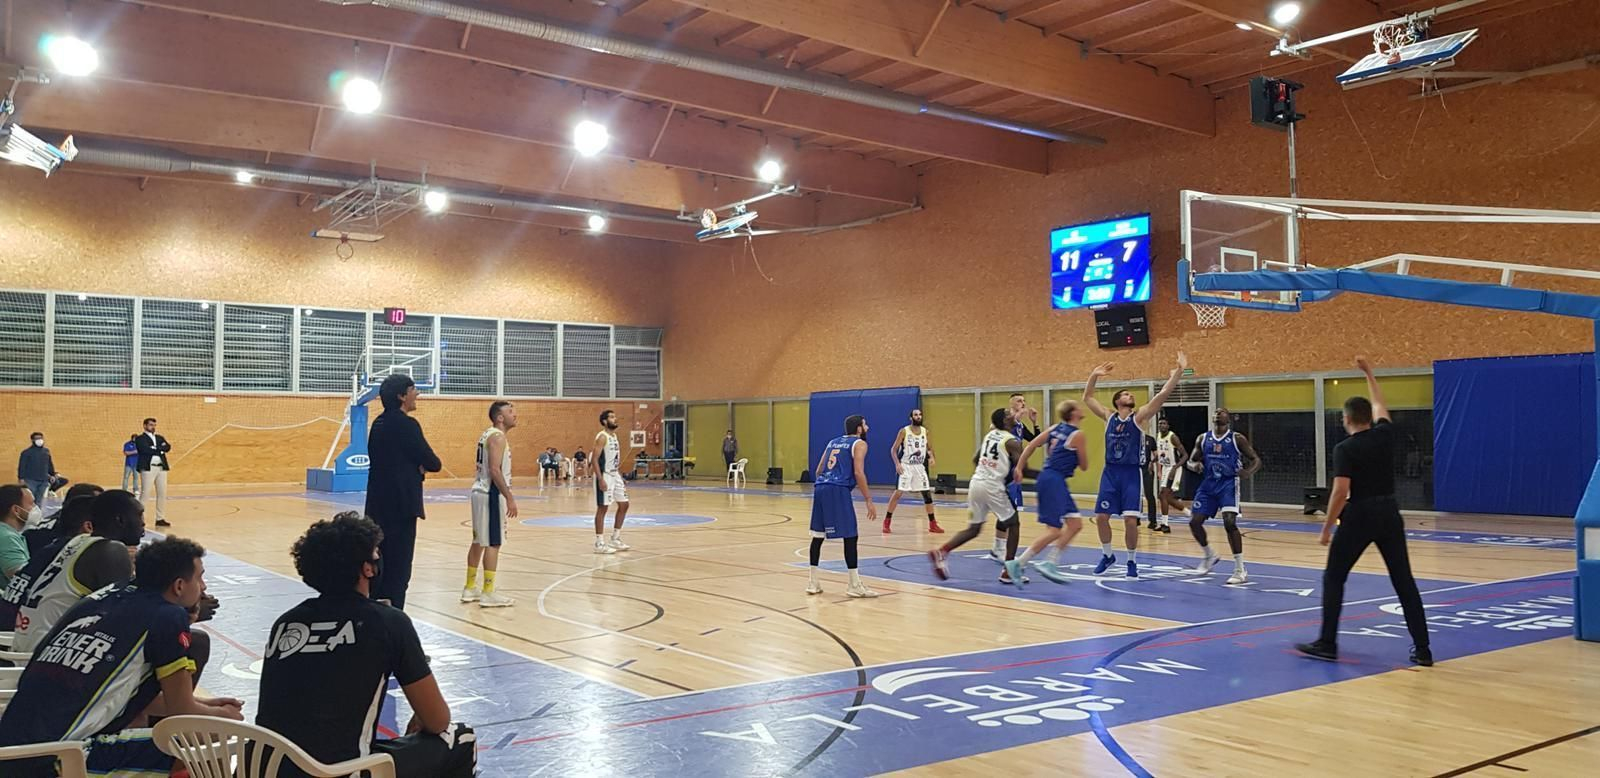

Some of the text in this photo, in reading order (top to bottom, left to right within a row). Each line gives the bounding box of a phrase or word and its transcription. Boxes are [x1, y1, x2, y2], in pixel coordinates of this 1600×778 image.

[1060, 249, 1080, 271] 11
[1123, 240, 1138, 263] 7
[392, 309, 404, 324] 10
[827, 448, 841, 470] 5
[983, 440, 999, 460] 14
[52, 631, 112, 660] ENER
[699, 658, 1207, 745] MARBELLA
